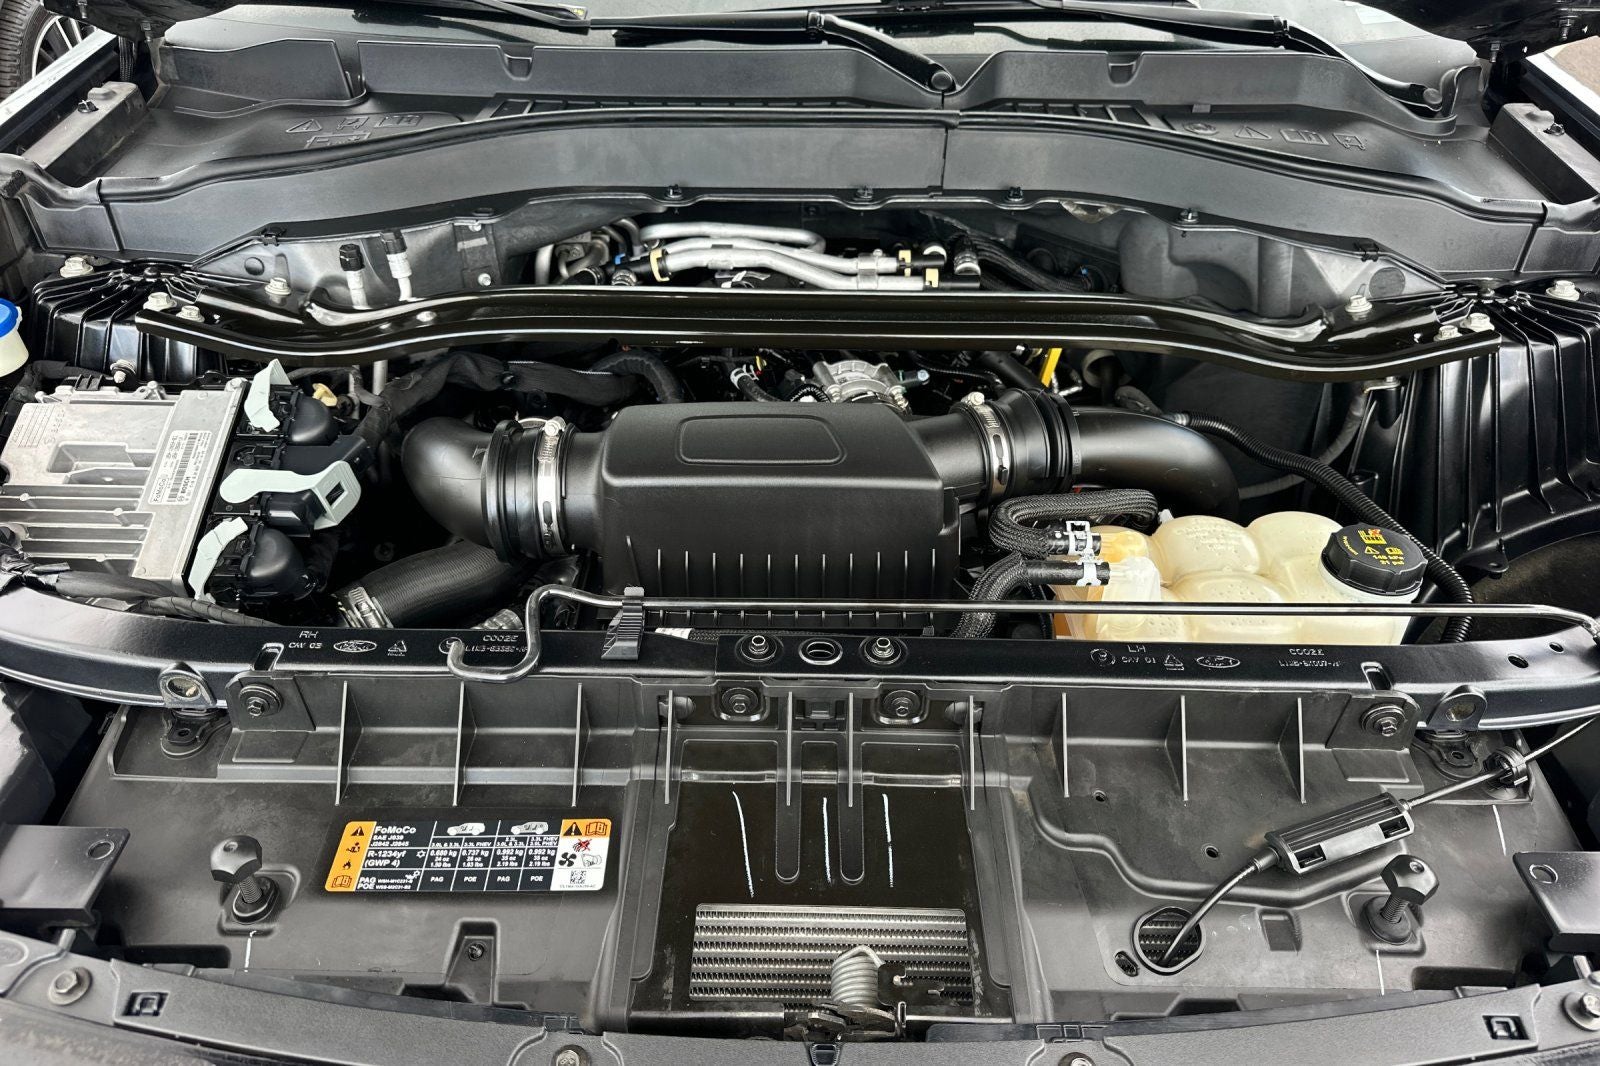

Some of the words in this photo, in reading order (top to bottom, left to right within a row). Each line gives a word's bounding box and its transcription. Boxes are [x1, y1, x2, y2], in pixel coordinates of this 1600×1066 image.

[180, 476, 191, 494] BOSCH
[299, 630, 319, 638] RH
[1127, 645, 1146, 653] LH
[375, 826, 417, 834] FoMoCo
[367, 850, 406, 858] R-1234yf
[480, 849, 489, 857] kg
[515, 849, 524, 857] kg
[547, 848, 556, 856] kg
[364, 859, 390, 867] (GWP
[391, 859, 401, 868] 4)
